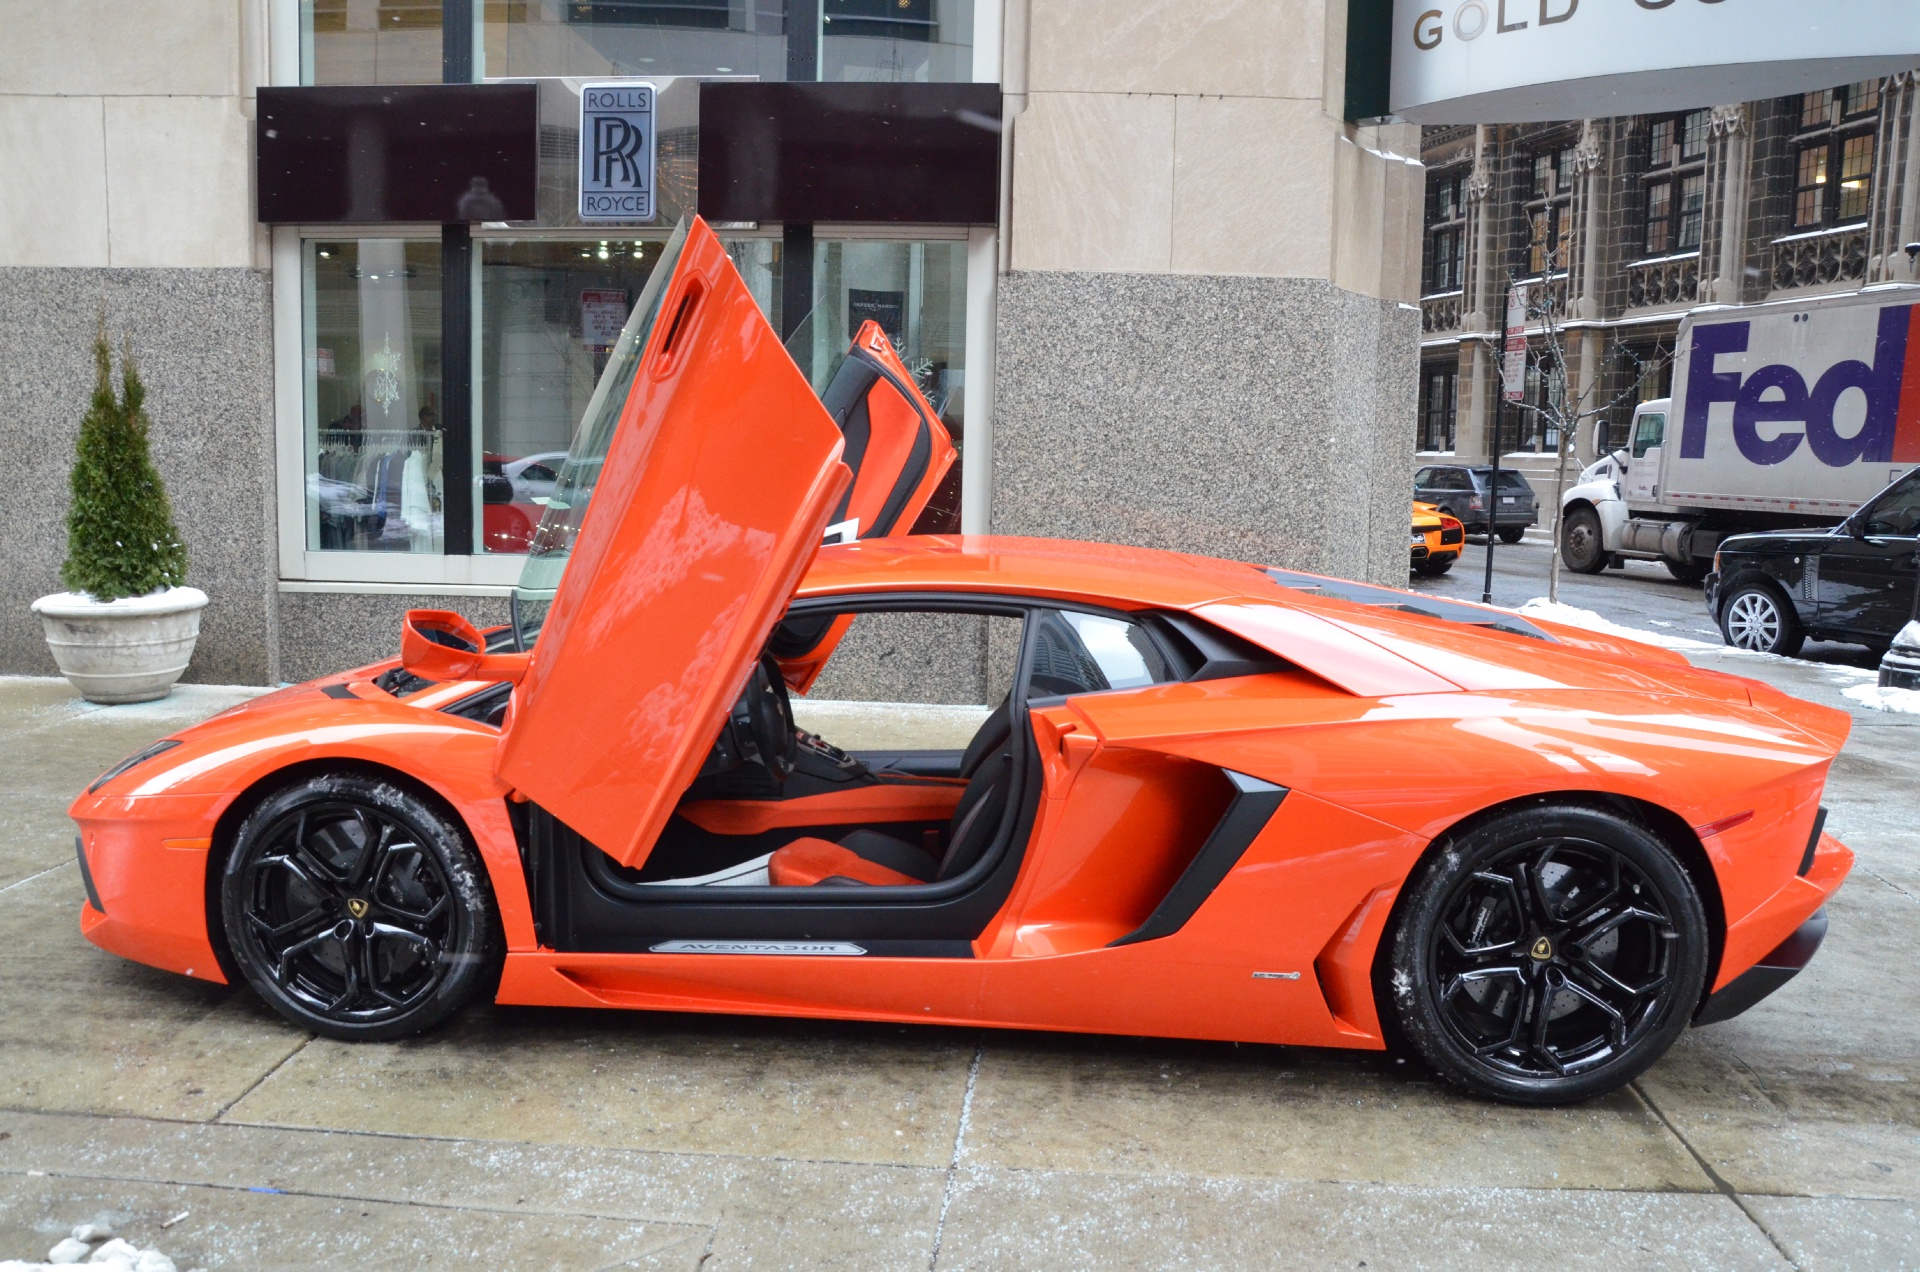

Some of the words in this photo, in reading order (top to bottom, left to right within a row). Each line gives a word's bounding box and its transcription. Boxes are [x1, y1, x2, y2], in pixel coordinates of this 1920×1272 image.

[1413, 0, 1579, 51] GOLD
[588, 92, 647, 108] ROLLS
[592, 116, 643, 188] RR
[587, 196, 645, 211] ROYCE
[1467, 906, 1488, 943] mborghini
[680, 943, 837, 951] AVENTADOR
